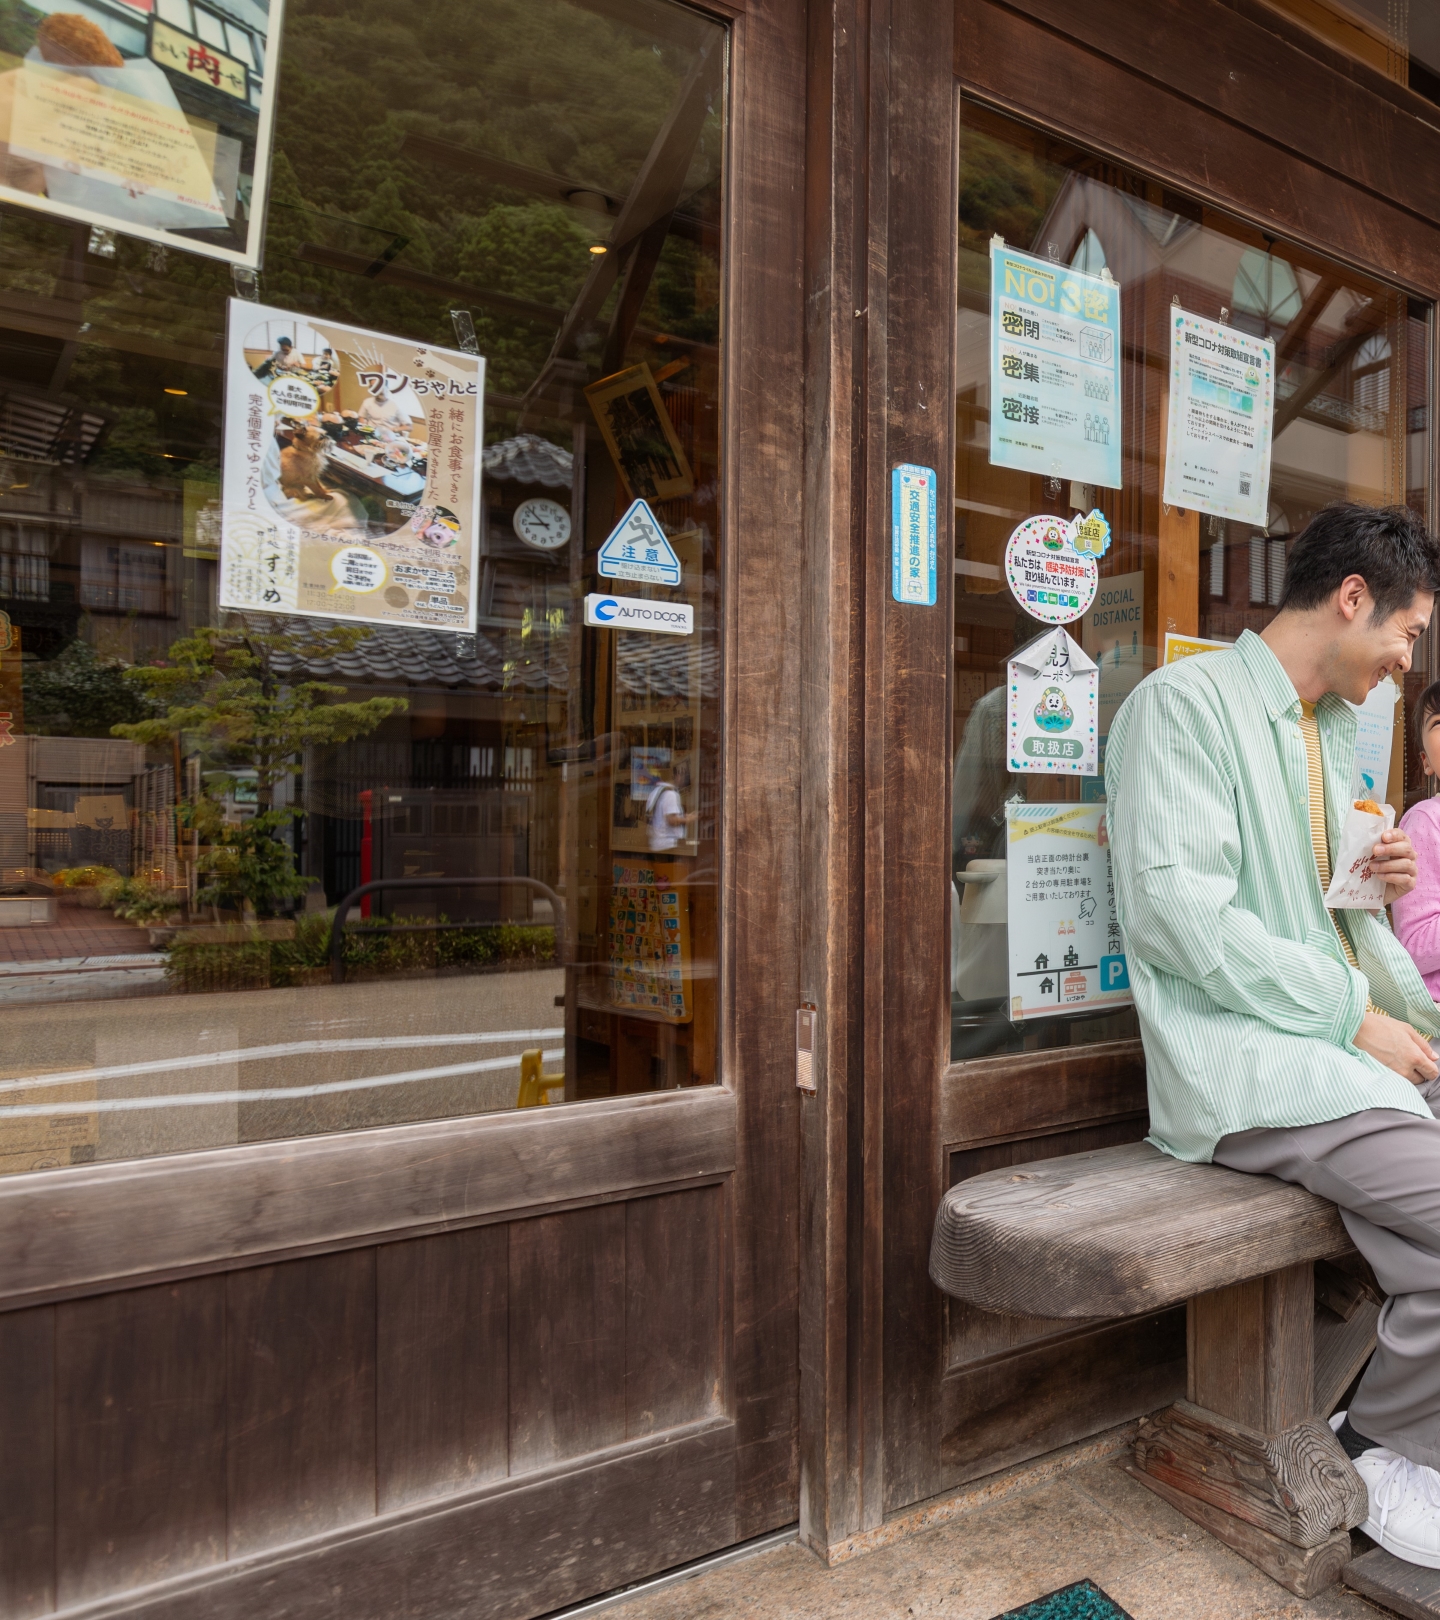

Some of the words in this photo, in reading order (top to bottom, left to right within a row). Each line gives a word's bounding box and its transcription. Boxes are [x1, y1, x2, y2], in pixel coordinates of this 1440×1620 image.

[1005, 268, 1055, 308] NO!
[1060, 280, 1109, 324] 3密
[1002, 310, 1040, 341] 密閉
[1185, 331, 1262, 369] 新型コロナ対策取組宣言書
[1002, 354, 1040, 384] 密集
[359, 370, 478, 397] ワンちゃんと
[1002, 397, 1040, 426] 密接
[246, 393, 263, 510] 完全個室でゆったりと
[427, 407, 444, 500] お部屋できました
[447, 398, 465, 503] 一緒にお食事できる
[909, 489, 921, 579] 交通安全推進の家
[622, 544, 659, 562] 注意
[394, 564, 455, 579] おまかせコース
[617, 570, 663, 582] 立ち止まらない
[620, 562, 661, 573] 駆け込まない
[1013, 555, 1091, 579] 私たちは、感染予防対策に
[1024, 570, 1079, 589] 取り組んでいます。
[1100, 587, 1135, 607] SOCIAL
[618, 607, 652, 620] AUTO
[653, 610, 687, 624] DOOR
[1093, 606, 1141, 627] DISTANCE
[1032, 739, 1075, 757] 取扱店
[1027, 852, 1090, 864] 当店正面の時計台裏
[623, 867, 657, 886] ひらがな
[1036, 865, 1081, 876] 突き当たり奥に
[1025, 877, 1092, 889] 2台分の専用駐車場を
[1025, 889, 1092, 902] ご用意いたしております
[1109, 960, 1124, 986] P
[1066, 993, 1086, 1002] いづみや
